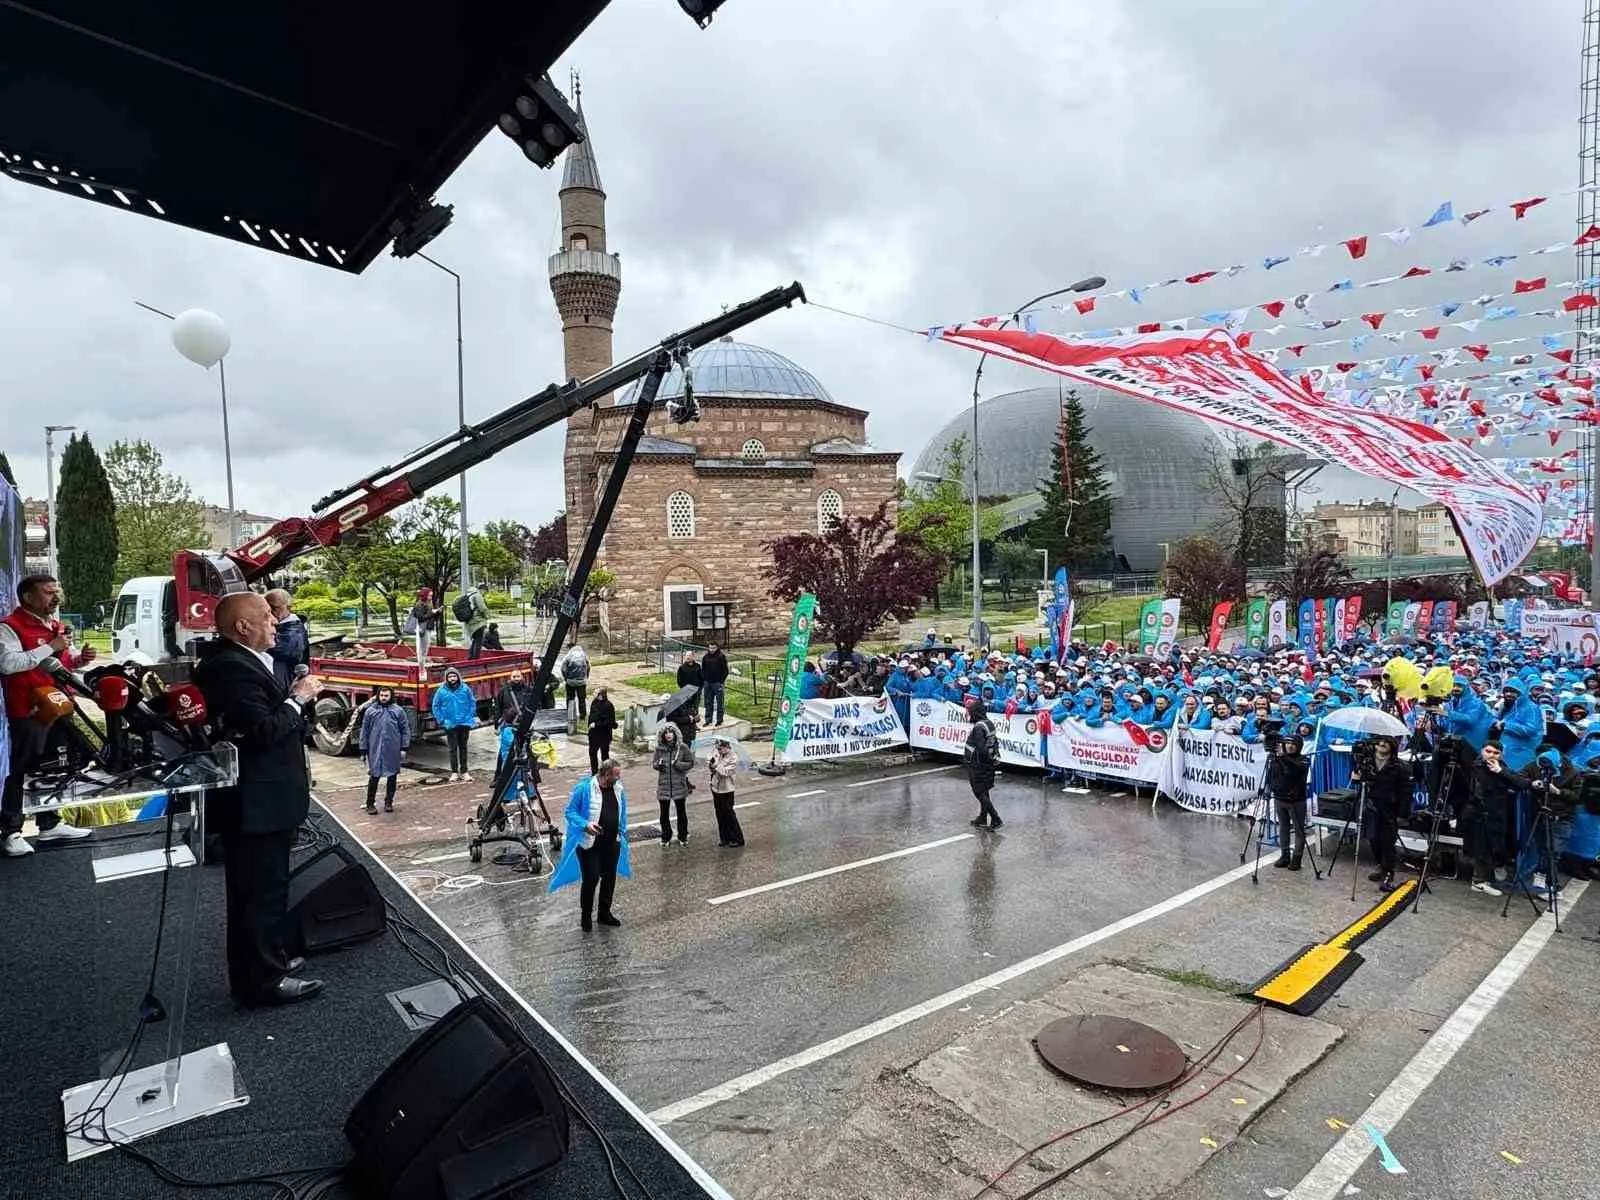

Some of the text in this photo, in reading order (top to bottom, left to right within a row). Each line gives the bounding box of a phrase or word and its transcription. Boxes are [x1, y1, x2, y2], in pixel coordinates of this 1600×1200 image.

[803, 743, 840, 757] İSTANBUL
[1071, 746, 1138, 766] ZONGULDAK
[1215, 743, 1255, 764] TEKSTİL
[1232, 773, 1256, 791] TANI
